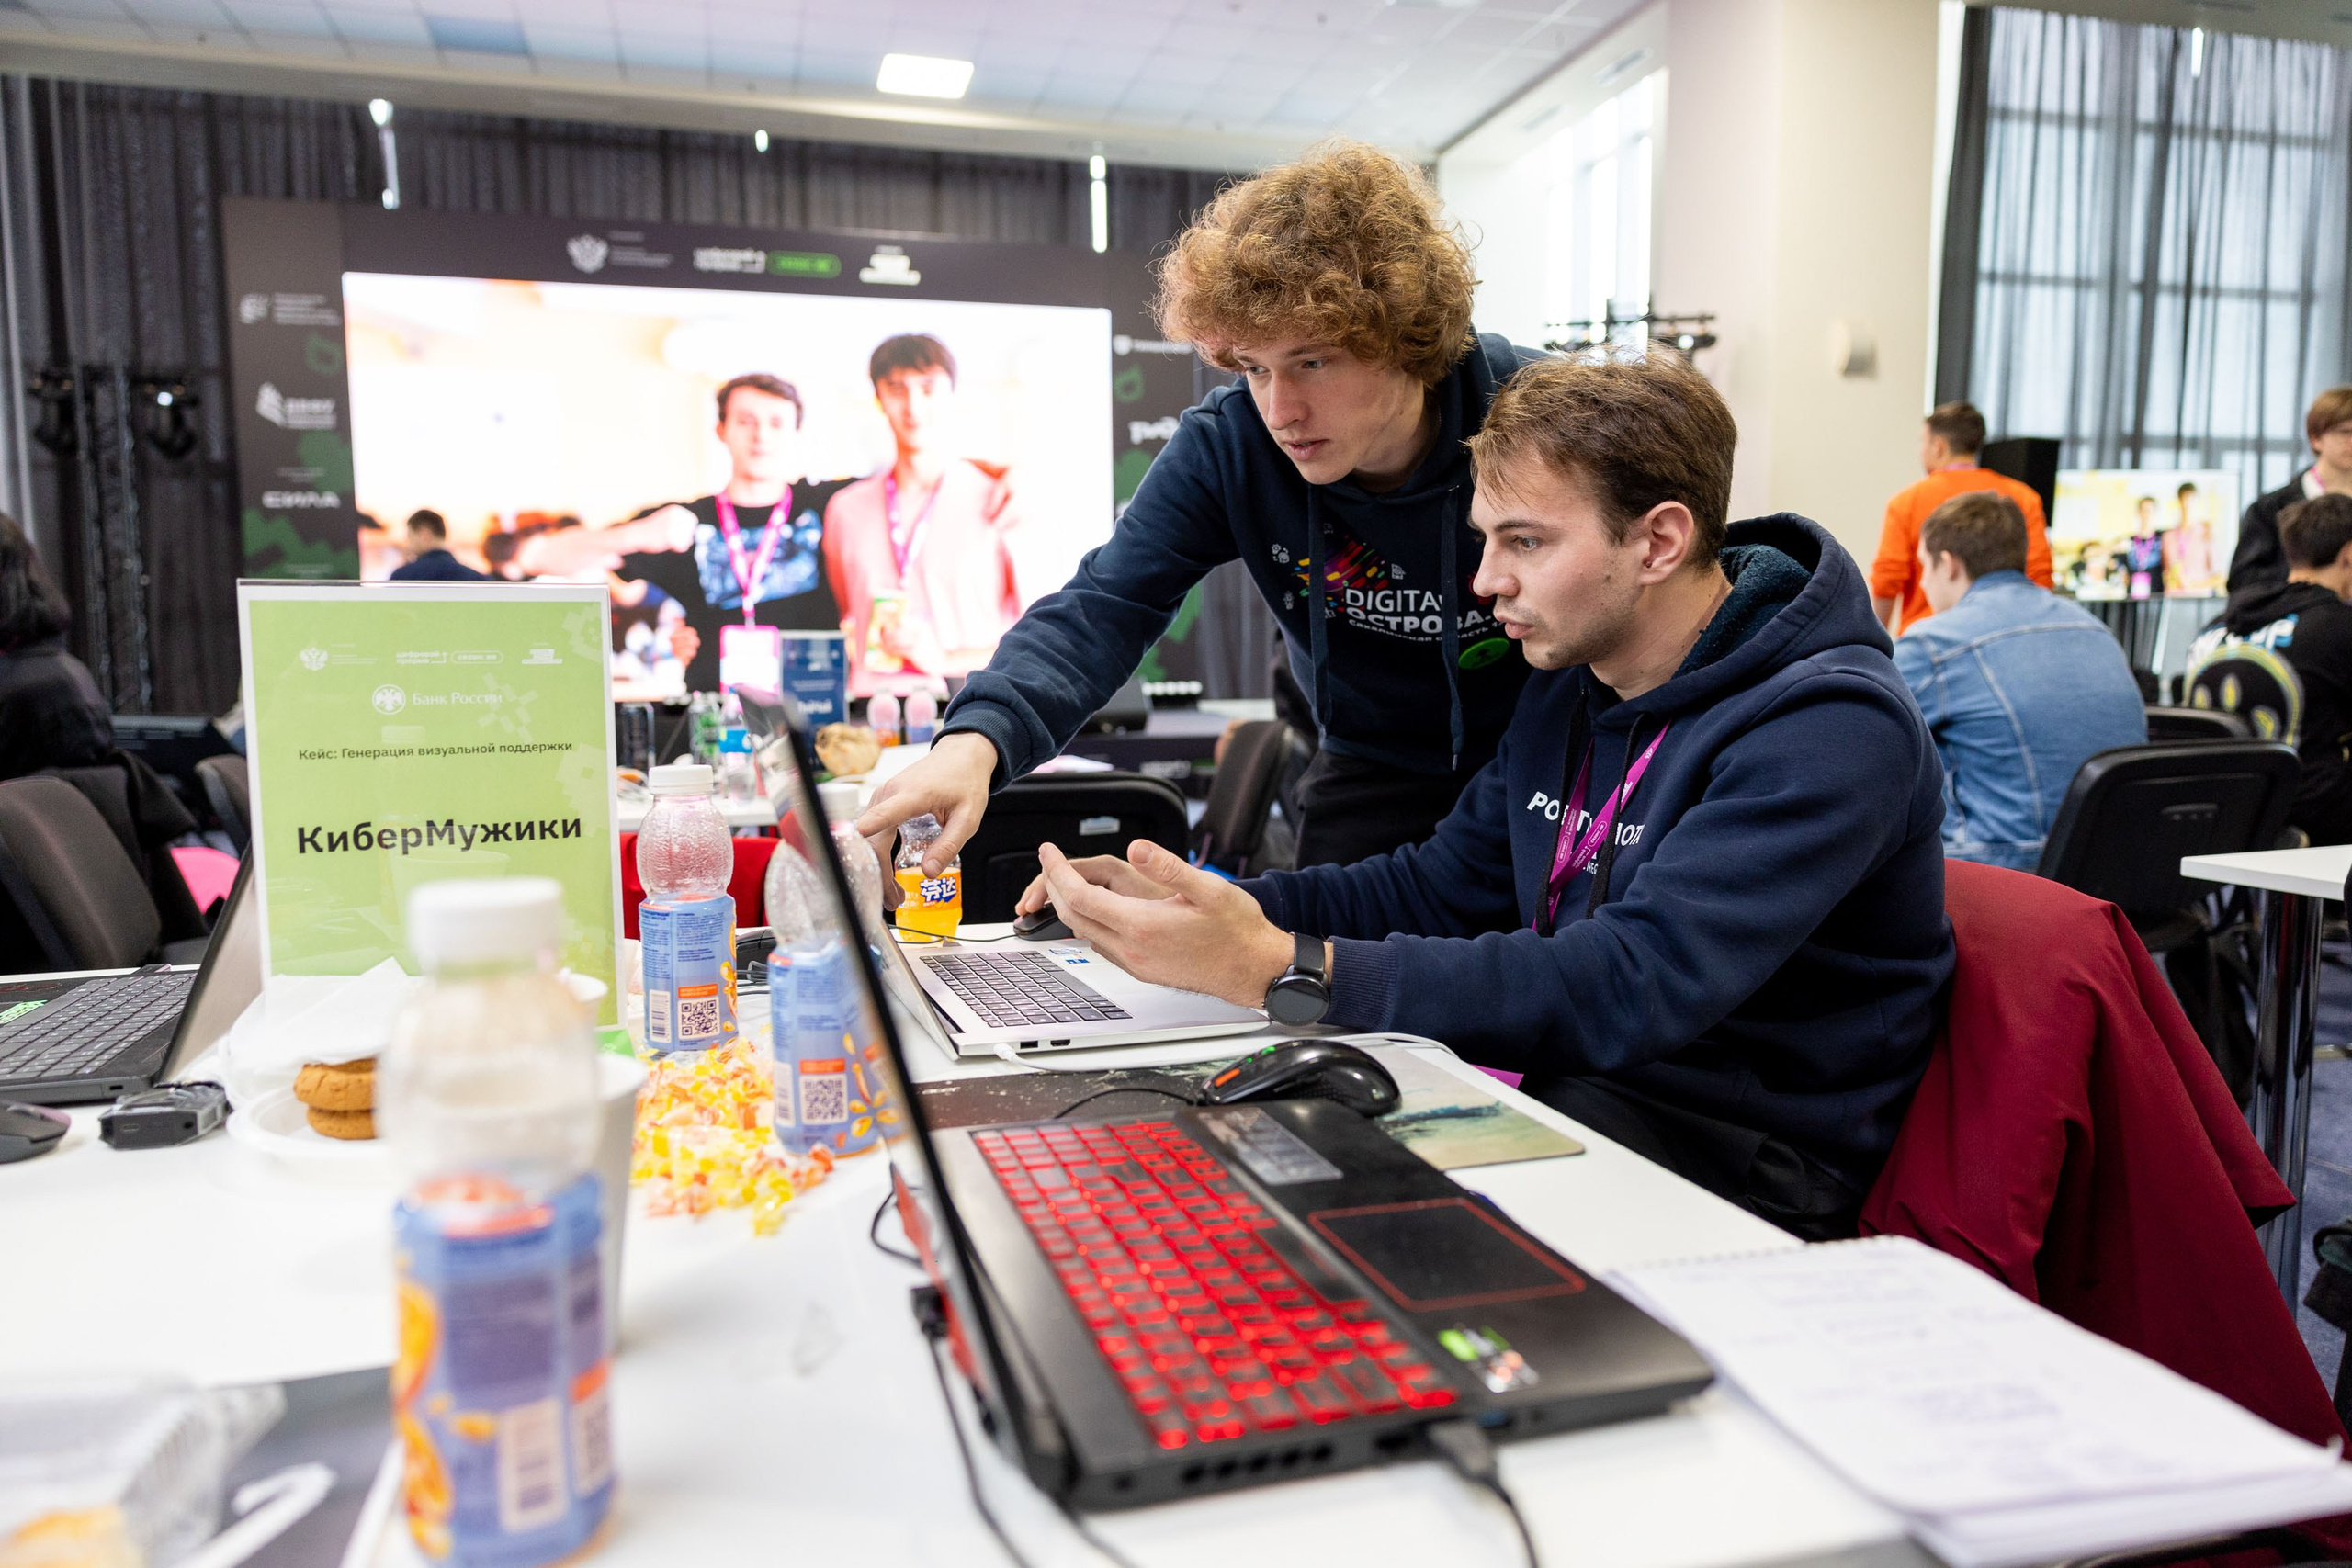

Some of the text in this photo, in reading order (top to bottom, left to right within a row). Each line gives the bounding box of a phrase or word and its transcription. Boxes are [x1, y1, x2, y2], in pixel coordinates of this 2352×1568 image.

[1346, 589, 1442, 612] DIGITA
[413, 692, 503, 706] Банк России
[299, 741, 572, 761] Кейс: Генерация визуальной поддержки
[297, 818, 582, 855] КиберМужики
[920, 876, 957, 902] 芬达
